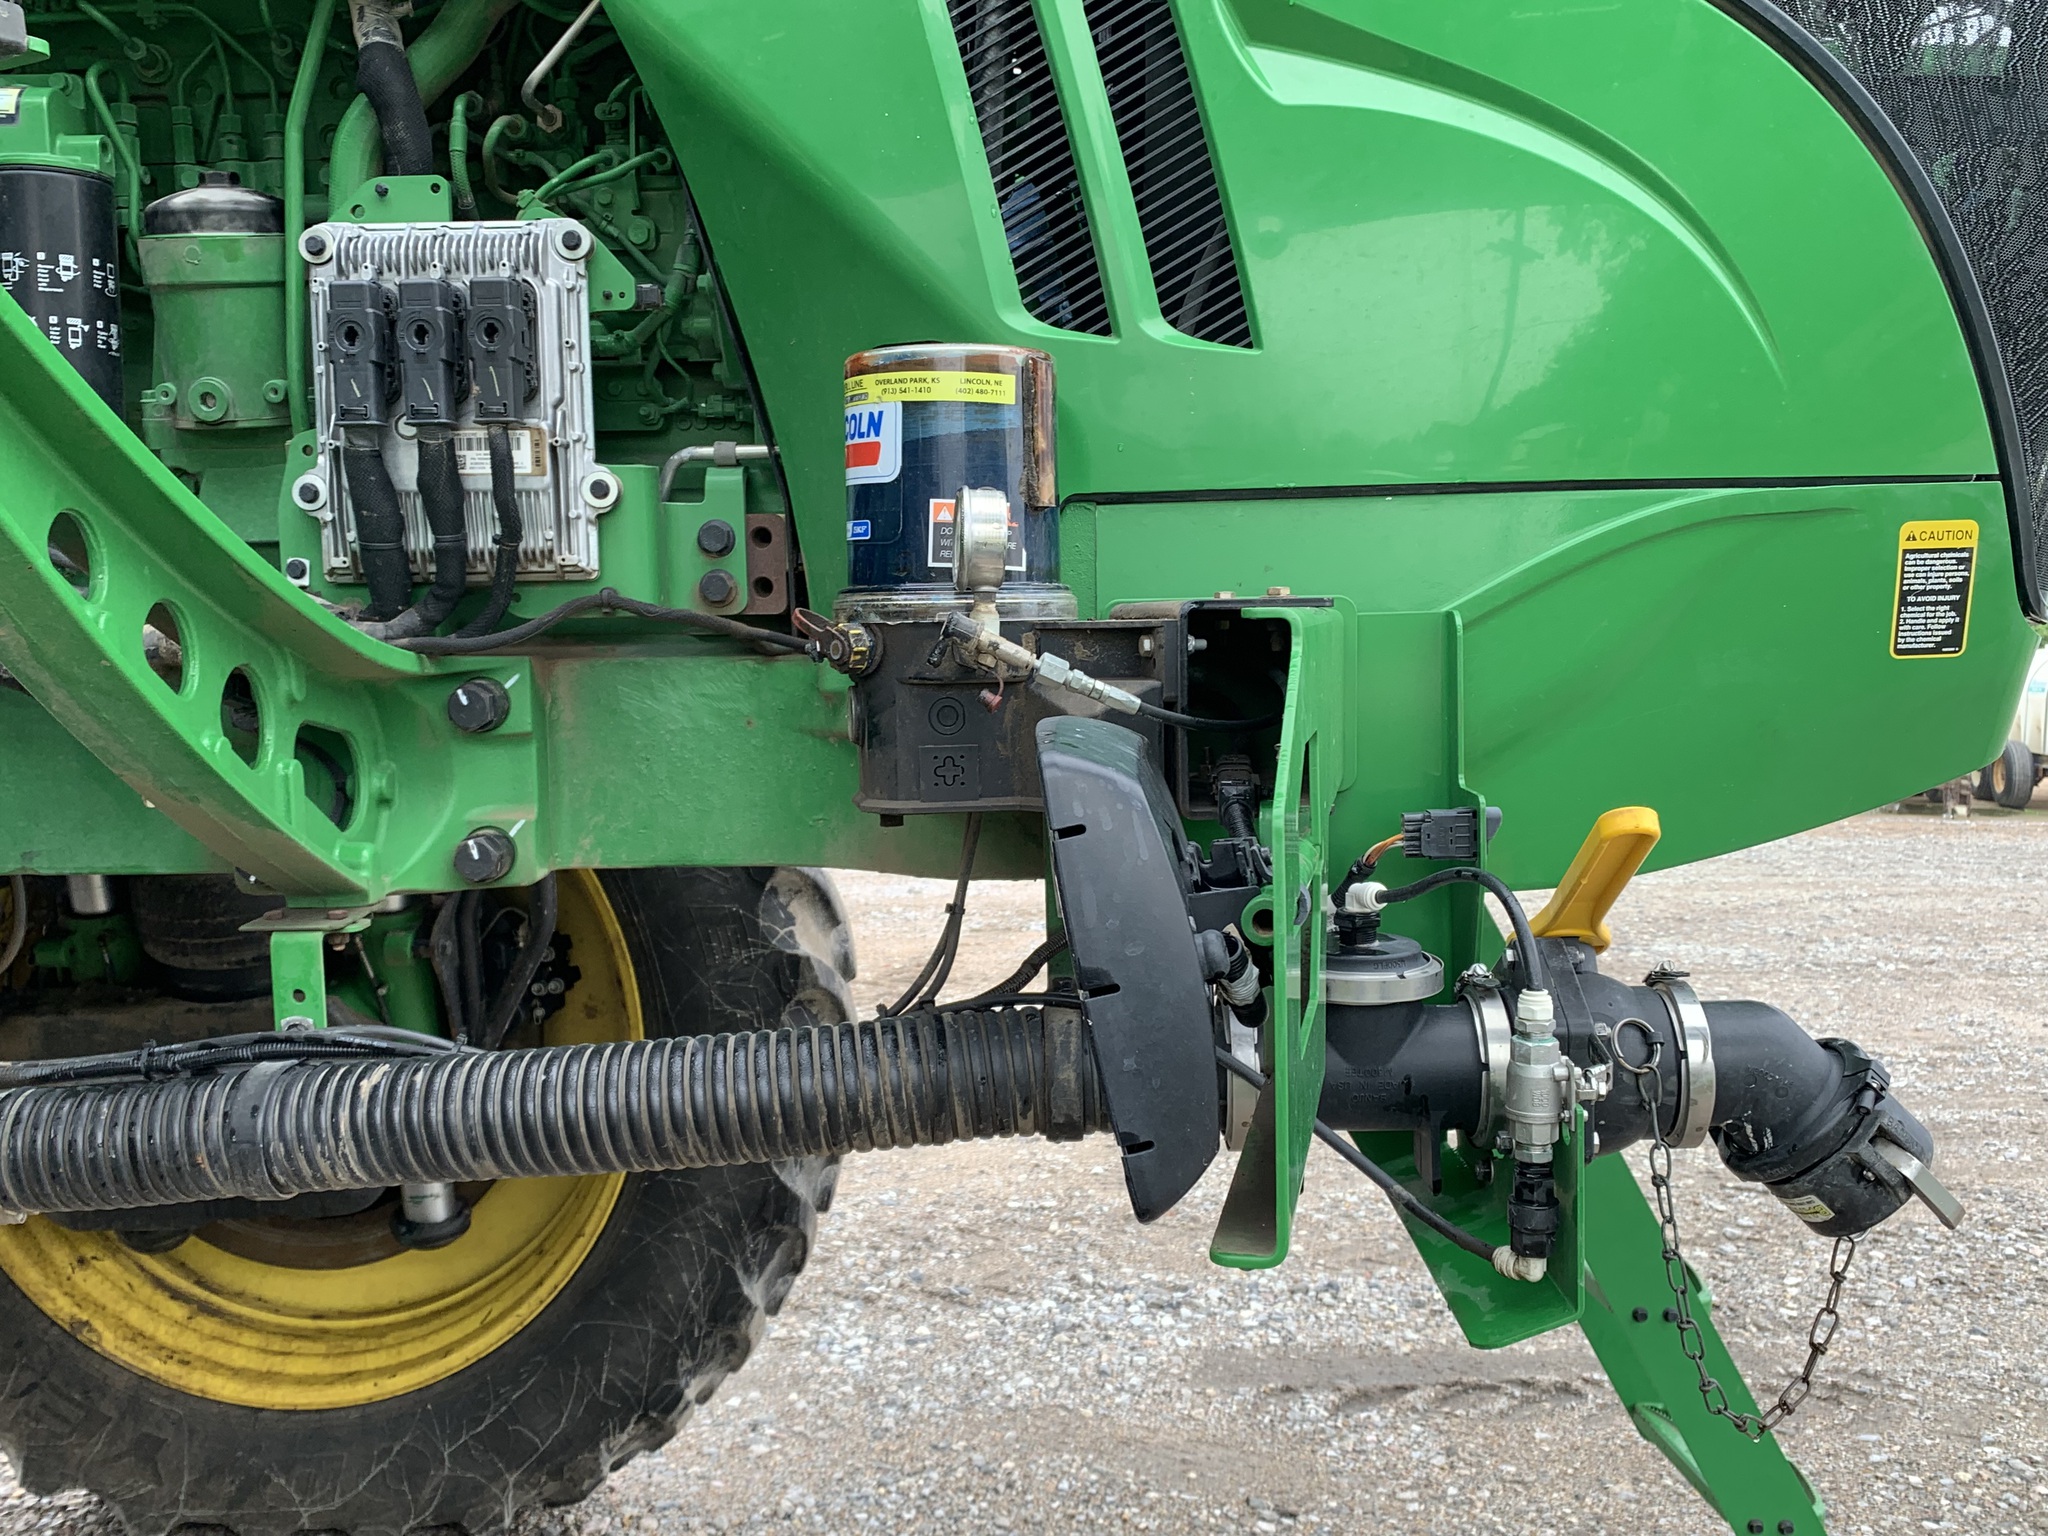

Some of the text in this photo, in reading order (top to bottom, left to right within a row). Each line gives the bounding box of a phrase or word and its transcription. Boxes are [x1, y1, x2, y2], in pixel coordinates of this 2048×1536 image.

[875, 377, 908, 386] OVERLAND
[960, 378, 992, 386] LINCOLN,
[881, 387, 897, 395] (913)
[956, 387, 974, 395] (402)
[853, 526, 867, 534] SKF
[1920, 530, 1973, 541] CAUTION
[1905, 552, 1939, 560] Agricultural
